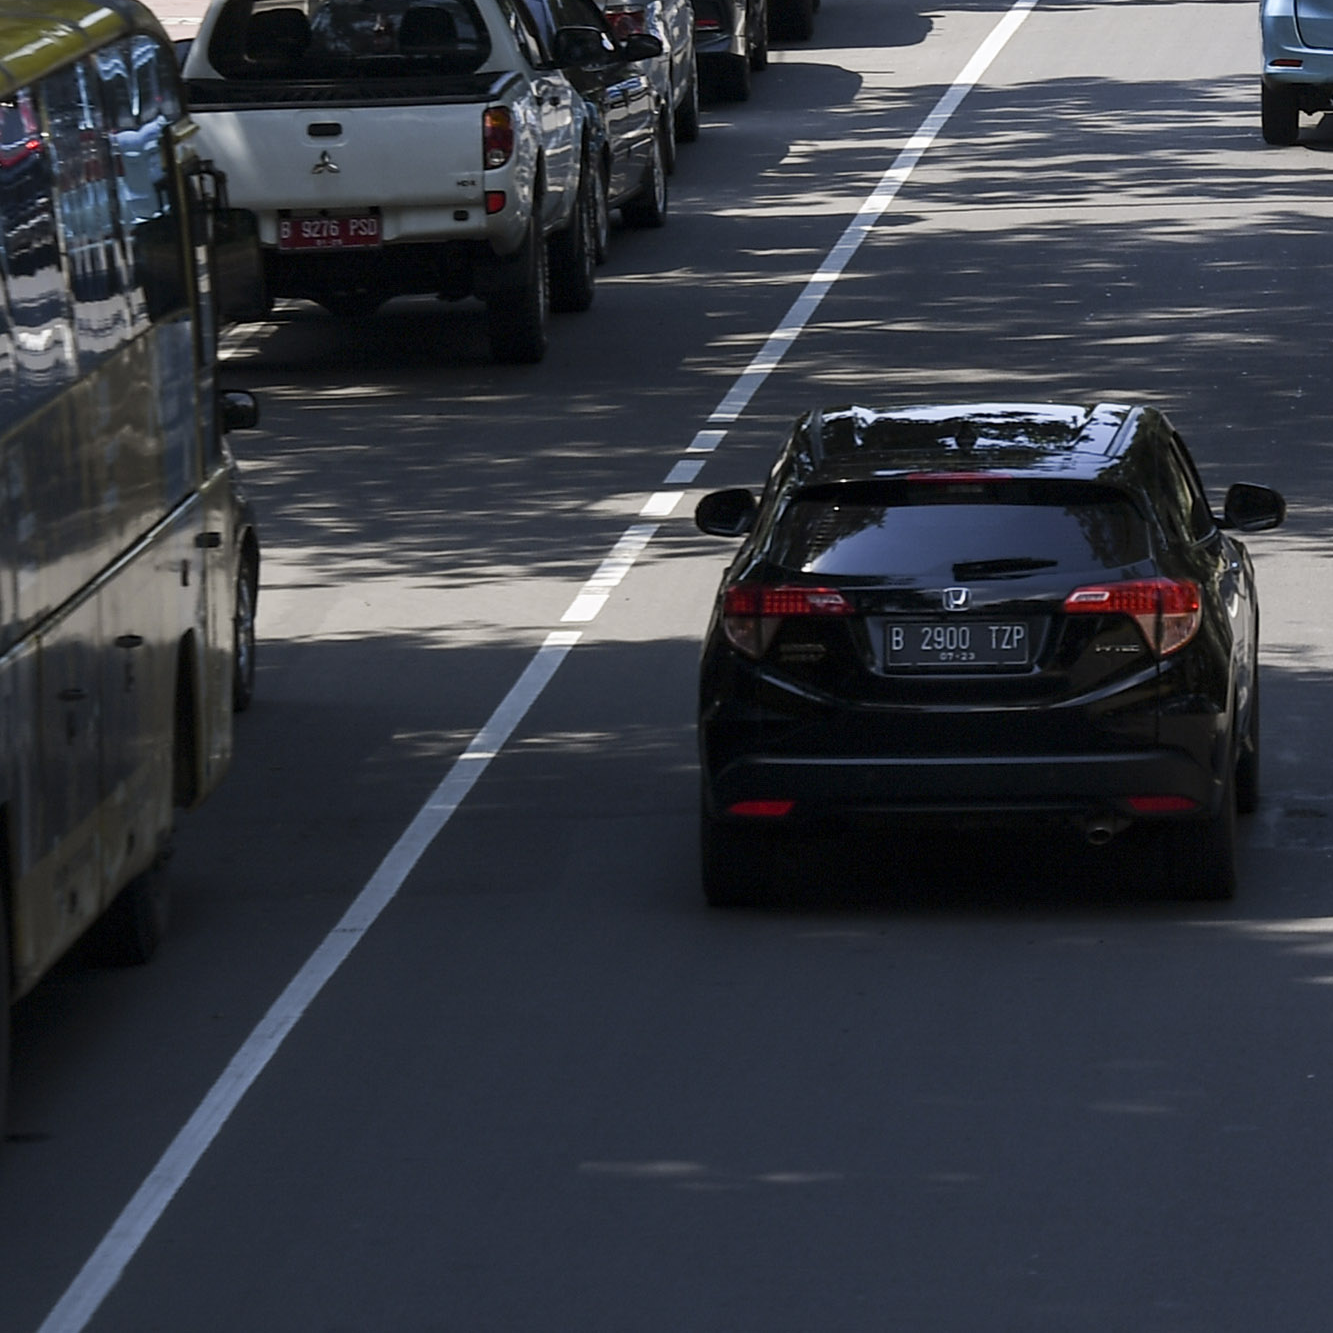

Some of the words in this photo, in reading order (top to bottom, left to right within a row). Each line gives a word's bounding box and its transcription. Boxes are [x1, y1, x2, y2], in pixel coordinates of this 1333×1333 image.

[280, 221, 291, 239] B
[302, 219, 340, 239] 9276
[349, 218, 378, 237] PSD
[891, 627, 904, 650] B
[920, 626, 971, 650] 2900
[988, 626, 1025, 649] TZP
[939, 652, 976, 661] 07-23
